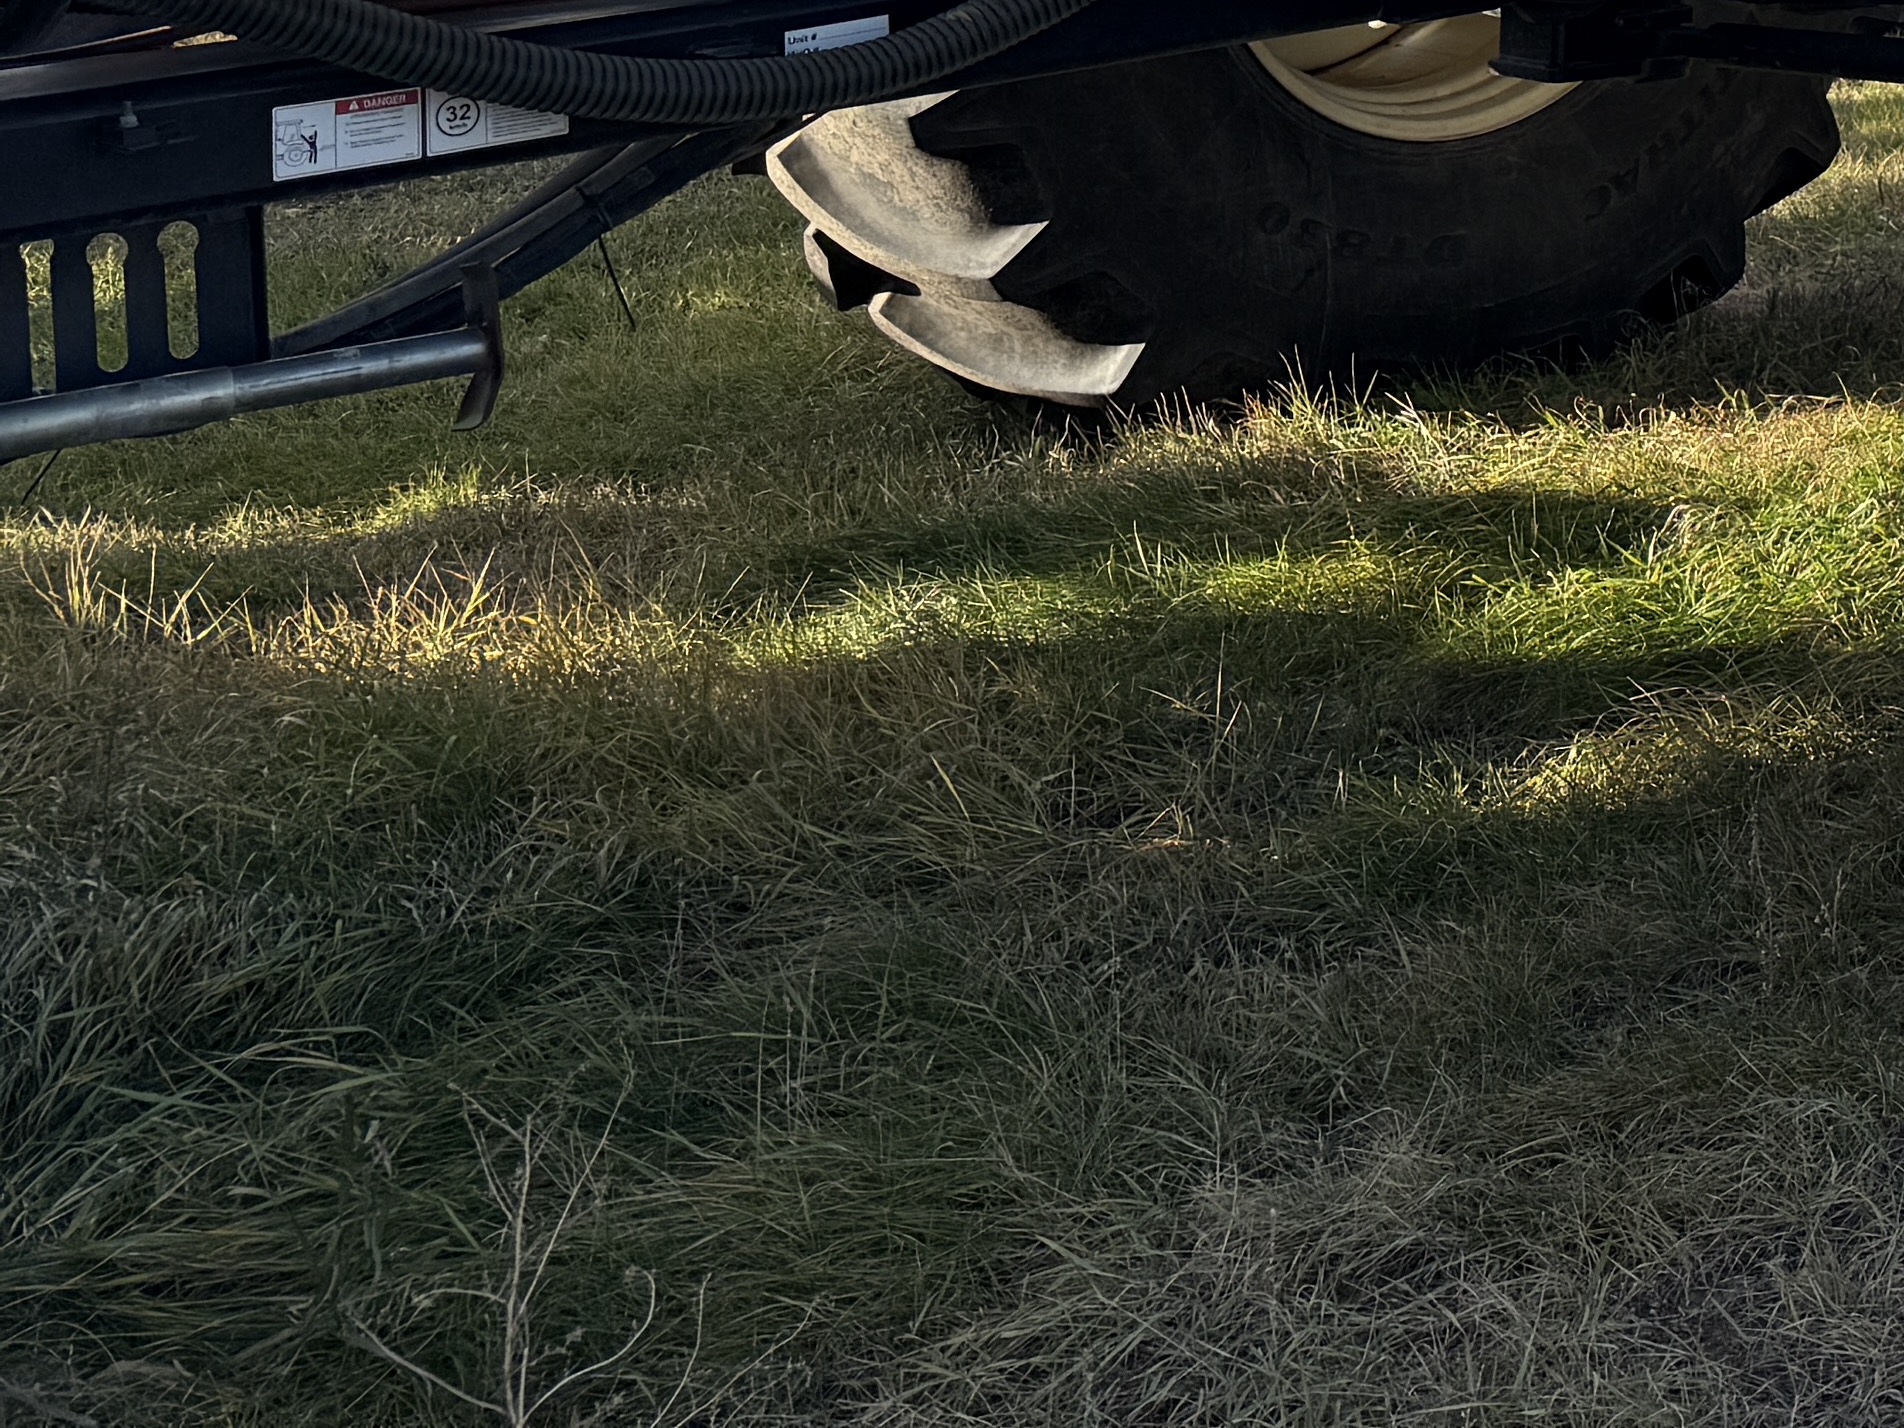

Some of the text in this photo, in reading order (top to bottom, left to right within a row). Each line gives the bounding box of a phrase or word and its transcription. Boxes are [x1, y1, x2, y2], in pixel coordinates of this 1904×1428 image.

[787, 35, 809, 45] Unit
[363, 94, 407, 109] DANGER
[445, 103, 472, 123] 32
